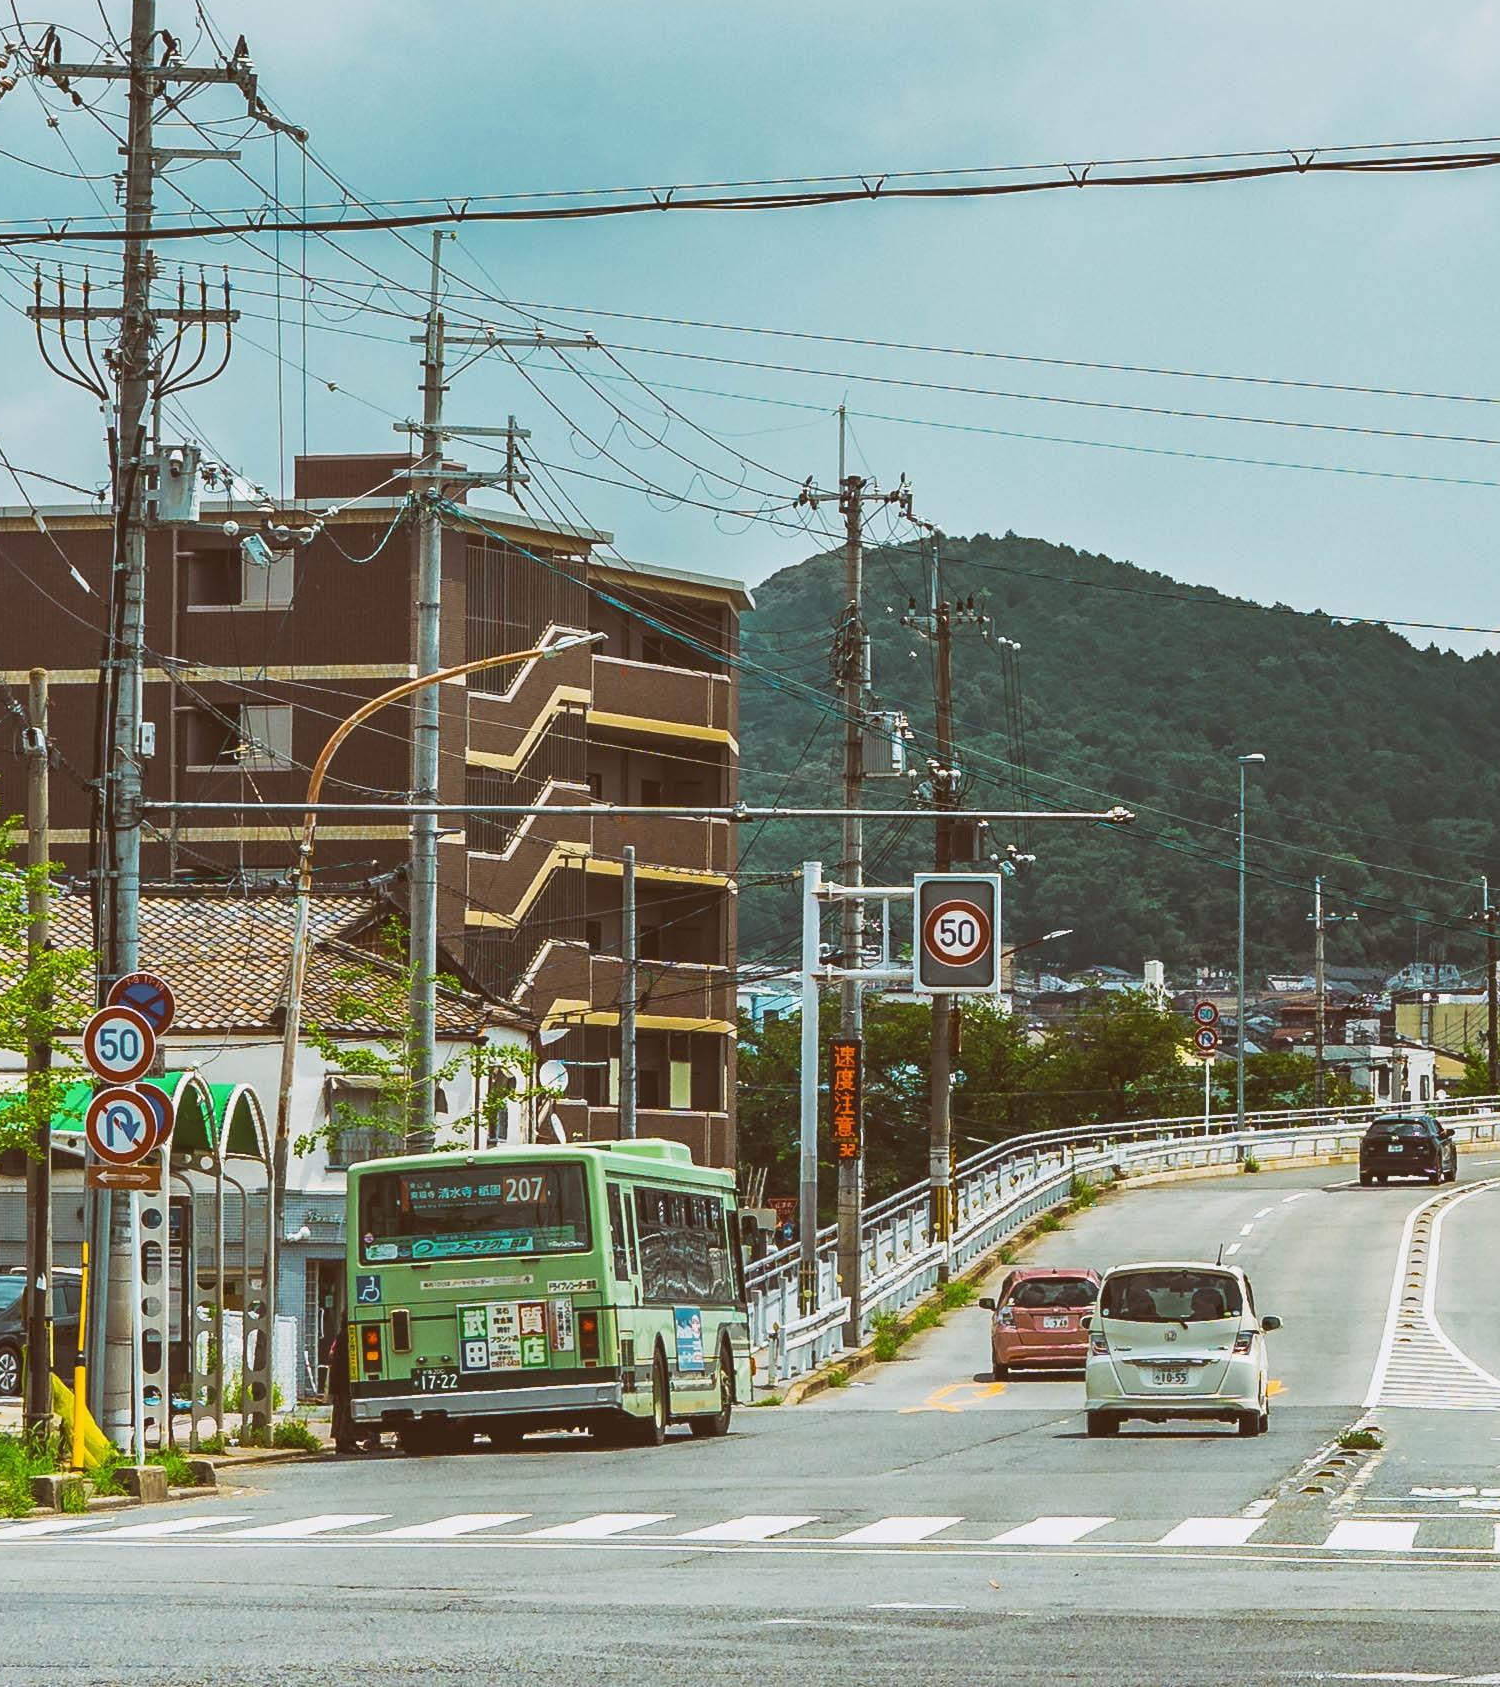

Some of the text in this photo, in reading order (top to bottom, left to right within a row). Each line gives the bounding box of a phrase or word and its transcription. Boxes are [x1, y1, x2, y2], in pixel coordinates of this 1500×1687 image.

[940, 919, 975, 948] 50
[1200, 1008, 1213, 1020] 50
[99, 1028, 139, 1062] 50
[834, 1045, 856, 1137] 速度注意
[505, 1176, 543, 1203] 207
[421, 1373, 459, 1390] 17-22
[1162, 1372, 1187, 1385] 10-55
